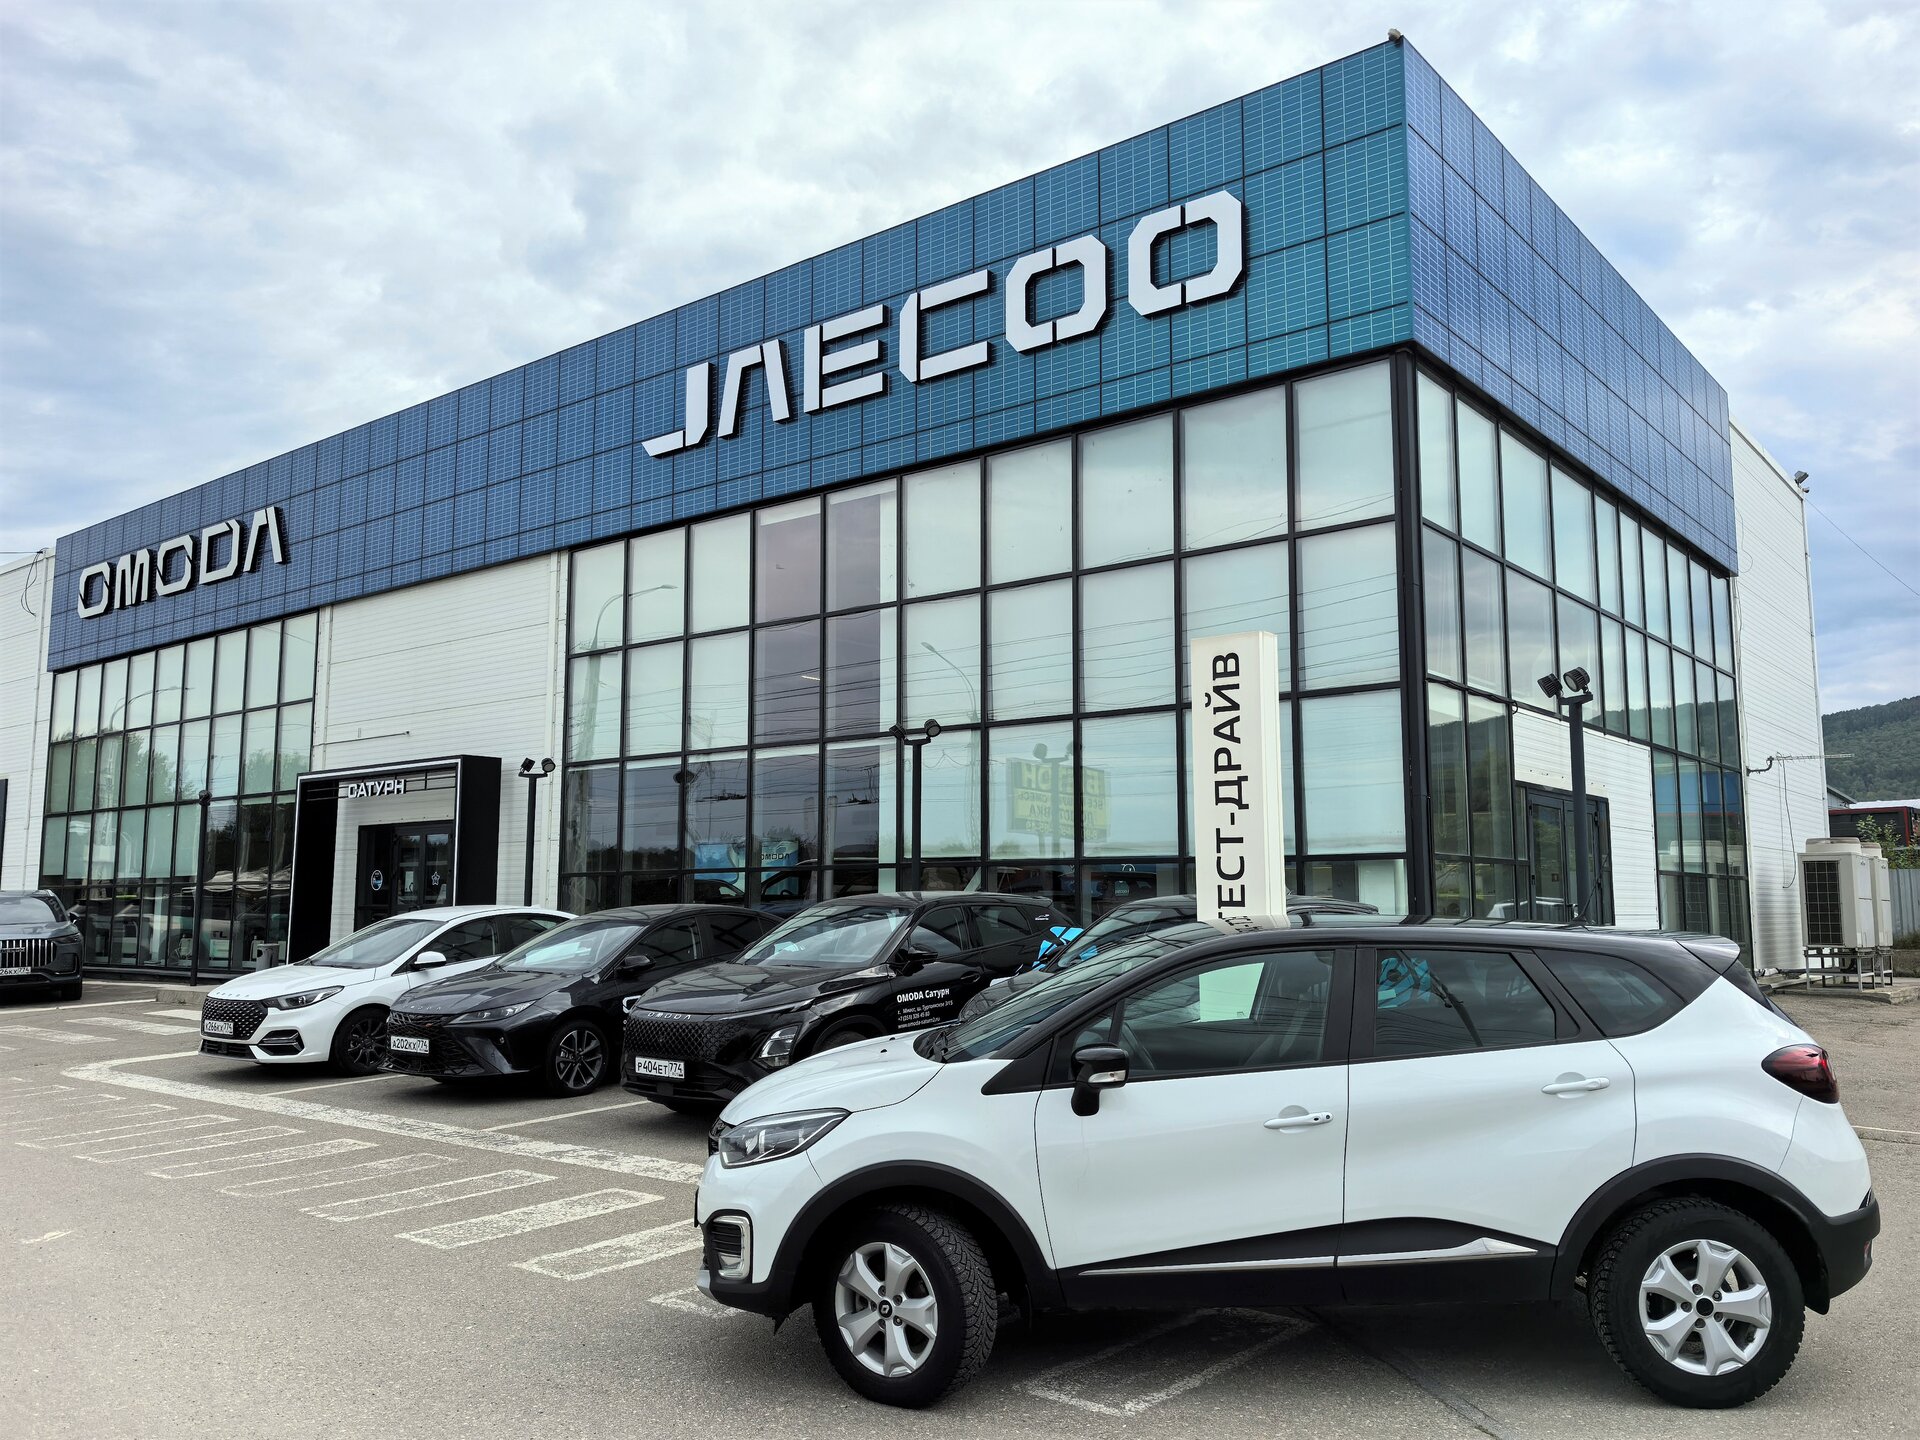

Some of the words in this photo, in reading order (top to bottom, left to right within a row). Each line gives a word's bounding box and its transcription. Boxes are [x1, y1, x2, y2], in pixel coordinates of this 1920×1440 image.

[641, 189, 1245, 458] JAECOO
[77, 506, 284, 619] OMODA
[347, 779, 406, 799] САТУРН
[1205, 652, 1249, 919] ЕСТ-ДРАЙВ
[648, 1012, 692, 1020] OMODA
[896, 991, 924, 1003] OMODA
[925, 988, 950, 999] Сатурн
